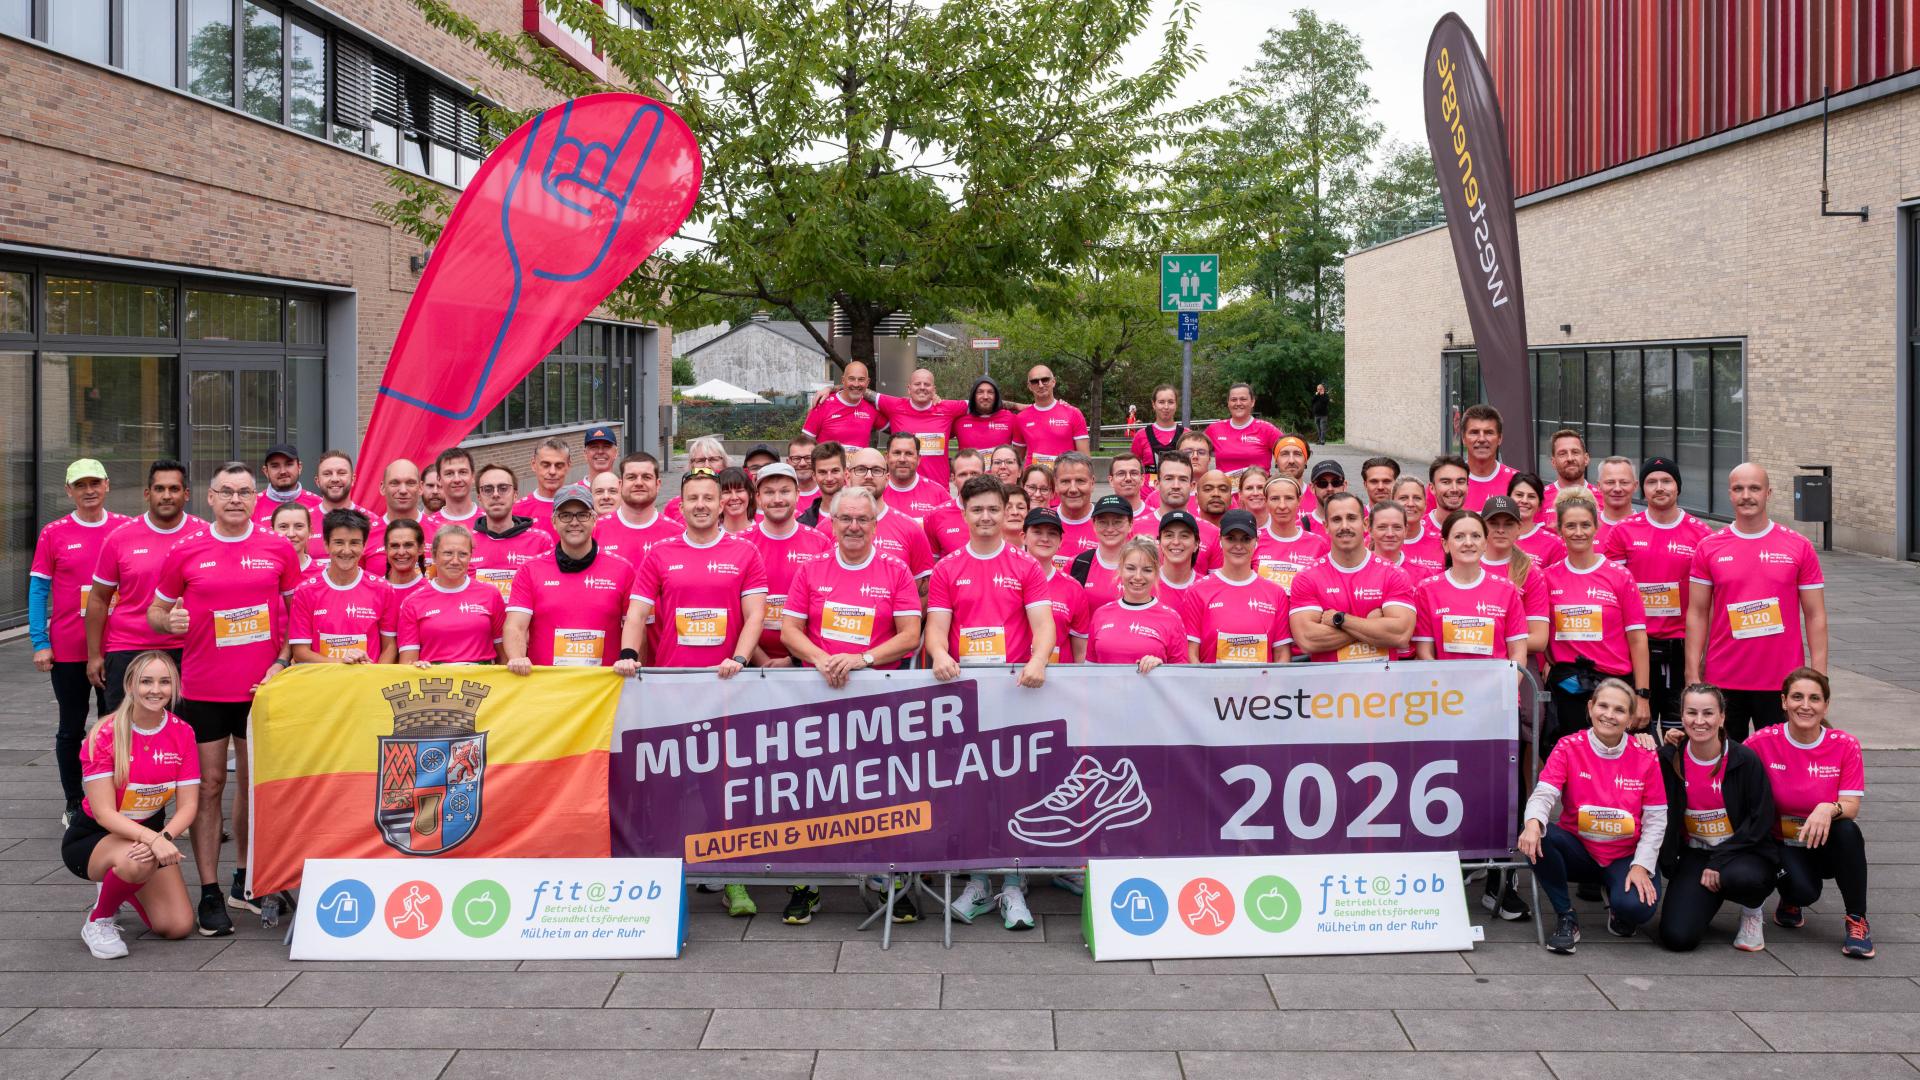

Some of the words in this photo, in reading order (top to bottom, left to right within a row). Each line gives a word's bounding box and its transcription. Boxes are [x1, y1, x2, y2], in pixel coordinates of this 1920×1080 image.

[1643, 594, 1670, 606] 2129
[767, 607, 784, 618] 219
[1740, 612, 1771, 626] 2120
[228, 619, 258, 634] 2178
[687, 621, 716, 633] 2138
[832, 616, 861, 631] 2981
[1562, 617, 1591, 629] 2189
[1454, 629, 1484, 641] 2147
[566, 643, 594, 654] 2158
[968, 640, 993, 653] 2113
[1228, 646, 1257, 658] 2169
[1213, 680, 1465, 727] westenergie
[636, 695, 965, 783] MÜLHEIMER
[724, 730, 1055, 821] FIRMENLAUF
[133, 795, 164, 808] 2210
[1219, 759, 1464, 840] 2026
[694, 830, 779, 858] LAUFEN
[784, 827, 801, 846] &
[806, 807, 921, 842] WANDERN
[1590, 819, 1622, 834] 2168
[1695, 821, 1727, 834] 2188
[525, 880, 662, 921] fit@job
[1318, 872, 1445, 916] fit@job
[544, 904, 610, 913] Betriebliche
[1335, 898, 1399, 907] Betriebliche
[1334, 907, 1440, 918] Gesundheitsförderung
[540, 914, 651, 925] Gesundheitsförderung
[1317, 921, 1366, 933] Mülheim
[1368, 923, 1383, 932] an
[1386, 920, 1408, 932] der
[1410, 919, 1439, 931] Ruhr
[520, 927, 571, 939] Mülheim
[573, 930, 589, 938] an
[591, 927, 613, 938] der
[616, 928, 646, 938] Ruhr
